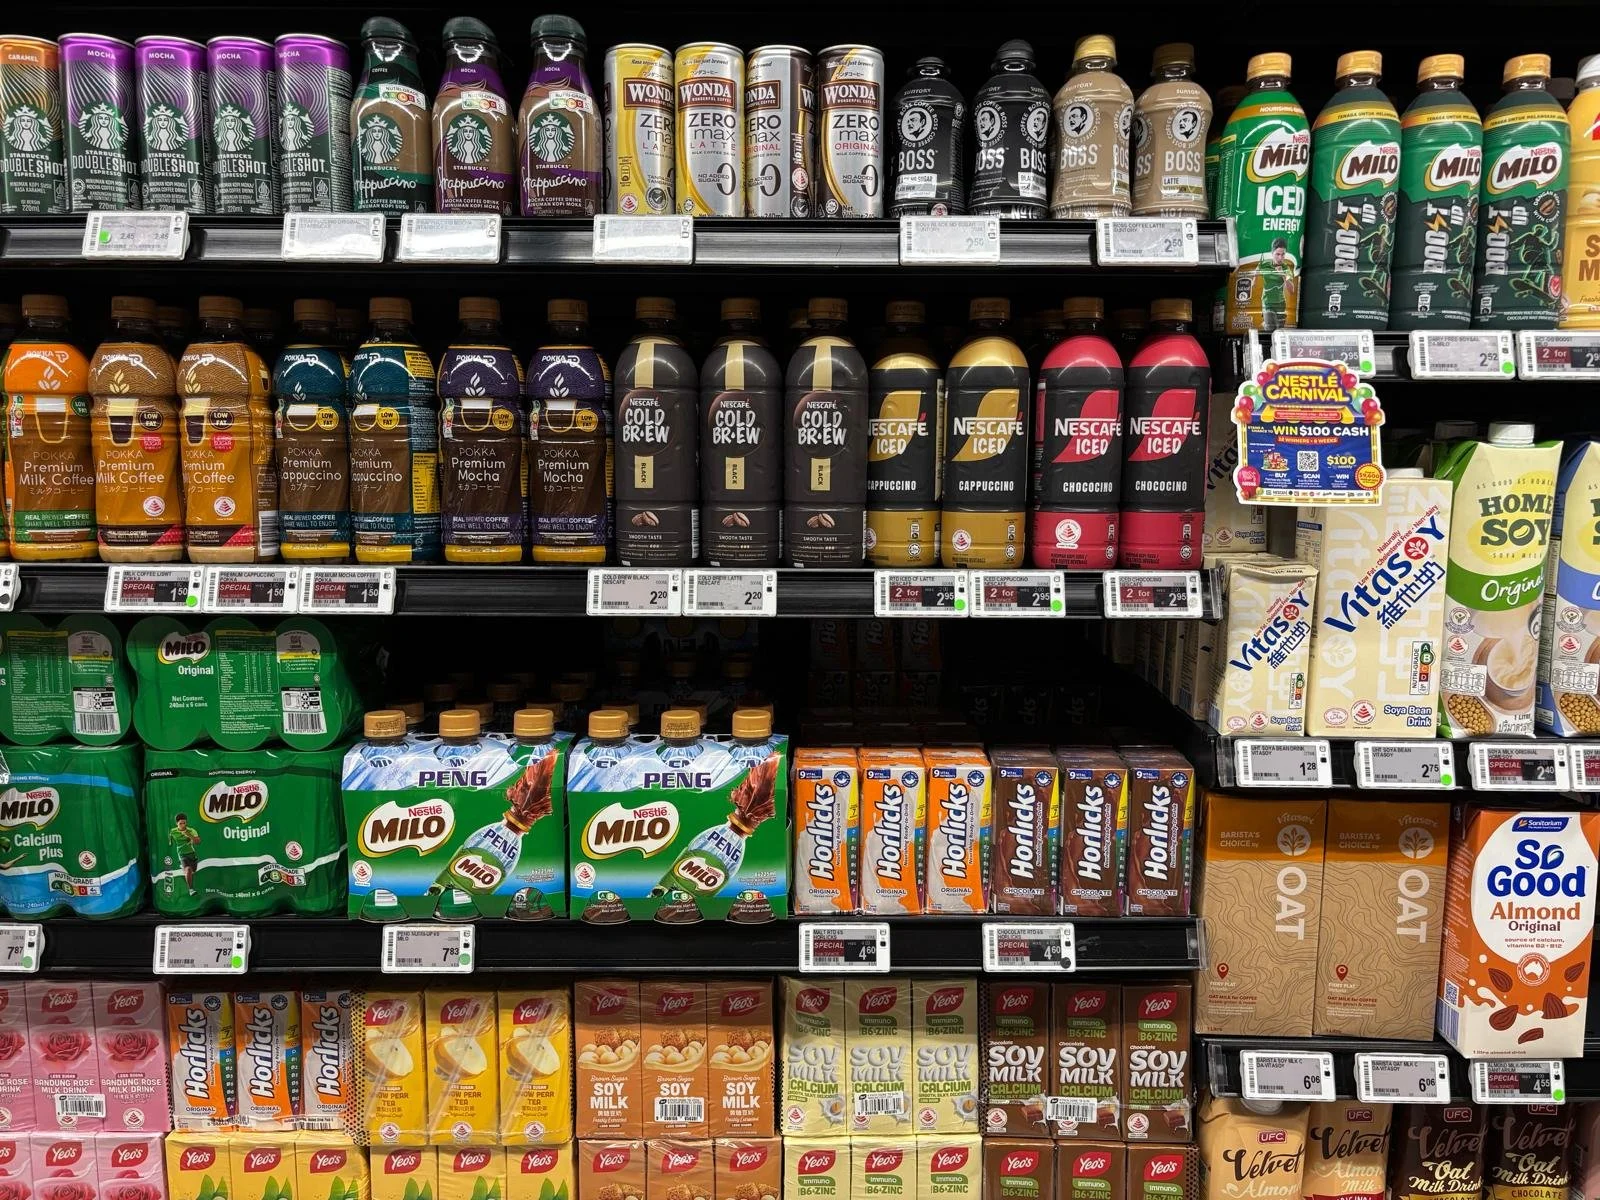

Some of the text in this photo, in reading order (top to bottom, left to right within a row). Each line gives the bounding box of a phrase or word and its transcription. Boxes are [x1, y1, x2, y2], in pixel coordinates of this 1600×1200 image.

[8, 54, 39, 62] CARAMEL
[88, 50, 116, 60] MOCHA
[680, 83, 732, 99] WONDA
[823, 84, 876, 100] WONDA
[688, 114, 736, 128] ZERO
[833, 115, 879, 129] ZERO
[694, 128, 735, 141] max
[839, 130, 879, 142] max
[85, 150, 125, 158] STARBUCKS
[899, 150, 935, 172] BOSS
[1061, 144, 1098, 168] BOSS
[1259, 144, 1309, 169] MILO
[1165, 151, 1200, 172] BOSS
[1347, 155, 1397, 178] MILO
[90, 169, 122, 177] ESPRESSO
[1497, 155, 1557, 183] MILO
[1257, 186, 1304, 216] ICED
[1263, 217, 1300, 231] ENERGY
[1278, 372, 1338, 387] NESTLÉ
[1266, 385, 1349, 401] CARNIVAL
[625, 408, 665, 426] COLD
[715, 410, 756, 427] COLD
[801, 411, 842, 429] COLD
[953, 412, 1024, 436] NESCAFÉ
[1055, 412, 1122, 436] NESCAFÉ
[1130, 412, 1201, 435] NESCAFÉ
[1273, 426, 1369, 437] WIN $100 CASH
[288, 448, 321, 457] POKKA
[459, 447, 496, 457] POKKA
[973, 438, 1006, 454] ICED
[1076, 439, 1108, 455] ICED
[1147, 437, 1182, 454] ICED
[33, 451, 75, 461] POKKA
[106, 450, 144, 459] POKKA
[544, 449, 579, 458] POKKA
[1327, 455, 1356, 465] $100
[24, 462, 84, 473] Premium
[100, 460, 155, 471] Premium
[283, 457, 331, 469] Premium
[451, 457, 505, 469] Premium
[538, 459, 589, 470] Premium
[19, 474, 94, 486] Milk Coffee
[119, 471, 164, 485] Coffee
[457, 469, 500, 482] Mocha
[543, 470, 583, 483] Mocha
[959, 480, 1014, 491] CAPPUCCINO
[1063, 482, 1112, 493] CHOCOCINO
[1135, 481, 1187, 491] CHOCOCINO
[1480, 519, 1551, 546] SOY
[1377, 530, 1401, 554] Naturally
[895, 588, 919, 598] 2 for
[164, 639, 207, 656] MILO
[178, 665, 214, 678] Original
[1384, 705, 1432, 715] Soya Bean
[1407, 715, 1431, 727] Drink
[418, 771, 487, 787] PENG
[643, 772, 712, 789] PENG
[209, 792, 262, 813] MILO
[408, 805, 443, 817] Nestlé
[633, 806, 668, 819] Nestlé
[371, 815, 446, 844] MILO
[1528, 819, 1562, 827] Sanitarium
[223, 822, 271, 841] Original
[595, 818, 671, 846] MILO
[806, 783, 836, 881] Horlicks
[874, 783, 904, 881] Horlicks
[1009, 784, 1036, 879] Horlicks
[14, 834, 62, 847] Calcium
[1220, 839, 1250, 847] CHOICE
[39, 846, 63, 860] Plus
[1515, 839, 1564, 870] So
[1487, 865, 1586, 897] Good
[1275, 866, 1307, 940] OAT
[1490, 901, 1580, 920] Almond
[1508, 921, 1561, 933] Original
[1146, 999, 1171, 1014] Yeo's
[1059, 1068, 1114, 1084] MILK
[593, 1083, 624, 1096] SOY
[921, 1081, 971, 1093] CALCIUM
[590, 1096, 628, 1109] MILK
[1261, 1132, 1283, 1141] UFC
[600, 1153, 625, 1168] Yeo's
[804, 1155, 830, 1170] Yeo's
[1223, 1144, 1304, 1181] Velvet
[1512, 1190, 1562, 1199] CHOCOLATE
